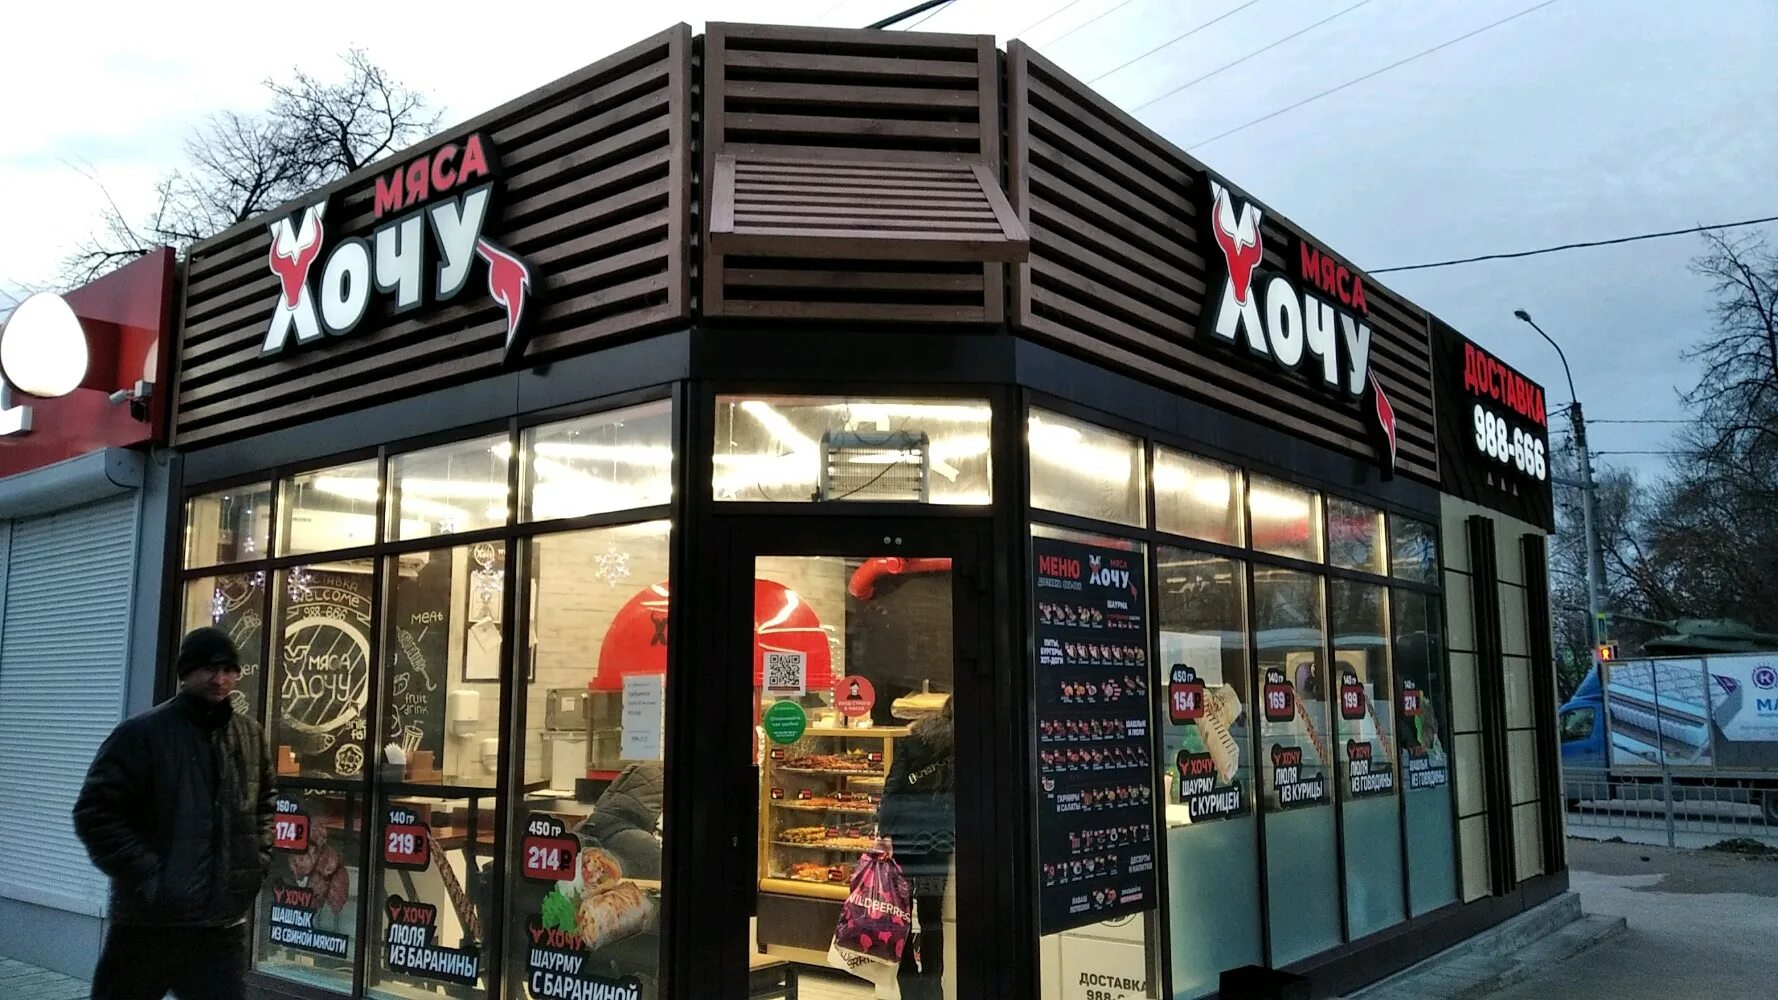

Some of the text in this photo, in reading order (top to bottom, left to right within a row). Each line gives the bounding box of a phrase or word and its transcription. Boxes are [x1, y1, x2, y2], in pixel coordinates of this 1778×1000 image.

[374, 132, 489, 218] МЯСА
[1301, 241, 1369, 314] МЯСА
[1465, 342, 1546, 427] ДОСТАВКА
[1474, 404, 1546, 481] 988-666
[1039, 554, 1081, 579] МЕНЮ
[303, 605, 348, 621] 988-666
[1172, 670, 1187, 683] 450
[404, 692, 428, 705] fruit
[1190, 759, 1215, 775] ХОЧУ
[1282, 751, 1301, 766] ХОЧУ
[1351, 760, 1368, 777] ЛЮЛЯ
[1182, 777, 1215, 796] ШАУРМУ
[1275, 766, 1298, 785] ЛЮЛЯ
[1352, 771, 1393, 793] ИЗ ГОВЯДИНЫ
[1190, 788, 1240, 817] С КУРИЦЕЙ
[1281, 780, 1323, 803] ИЗ КУРИЦЫ
[389, 811, 405, 824] 140
[528, 820, 550, 836] 450
[285, 889, 313, 906] ХОЧУ
[271, 906, 312, 928] ШАШЛЫК
[404, 906, 434, 925] ХОЧУ
[271, 926, 347, 954] ИЗ СВИНОЙ МЯКОТИ
[388, 924, 426, 948] ЛЮЛЯ
[547, 928, 584, 949] ХОЧУ
[390, 946, 477, 979] ИЗ БАРАНИНЫ
[530, 948, 582, 975] ШАУРМУ
[532, 971, 639, 1000] С БАРАНИНОЙ
